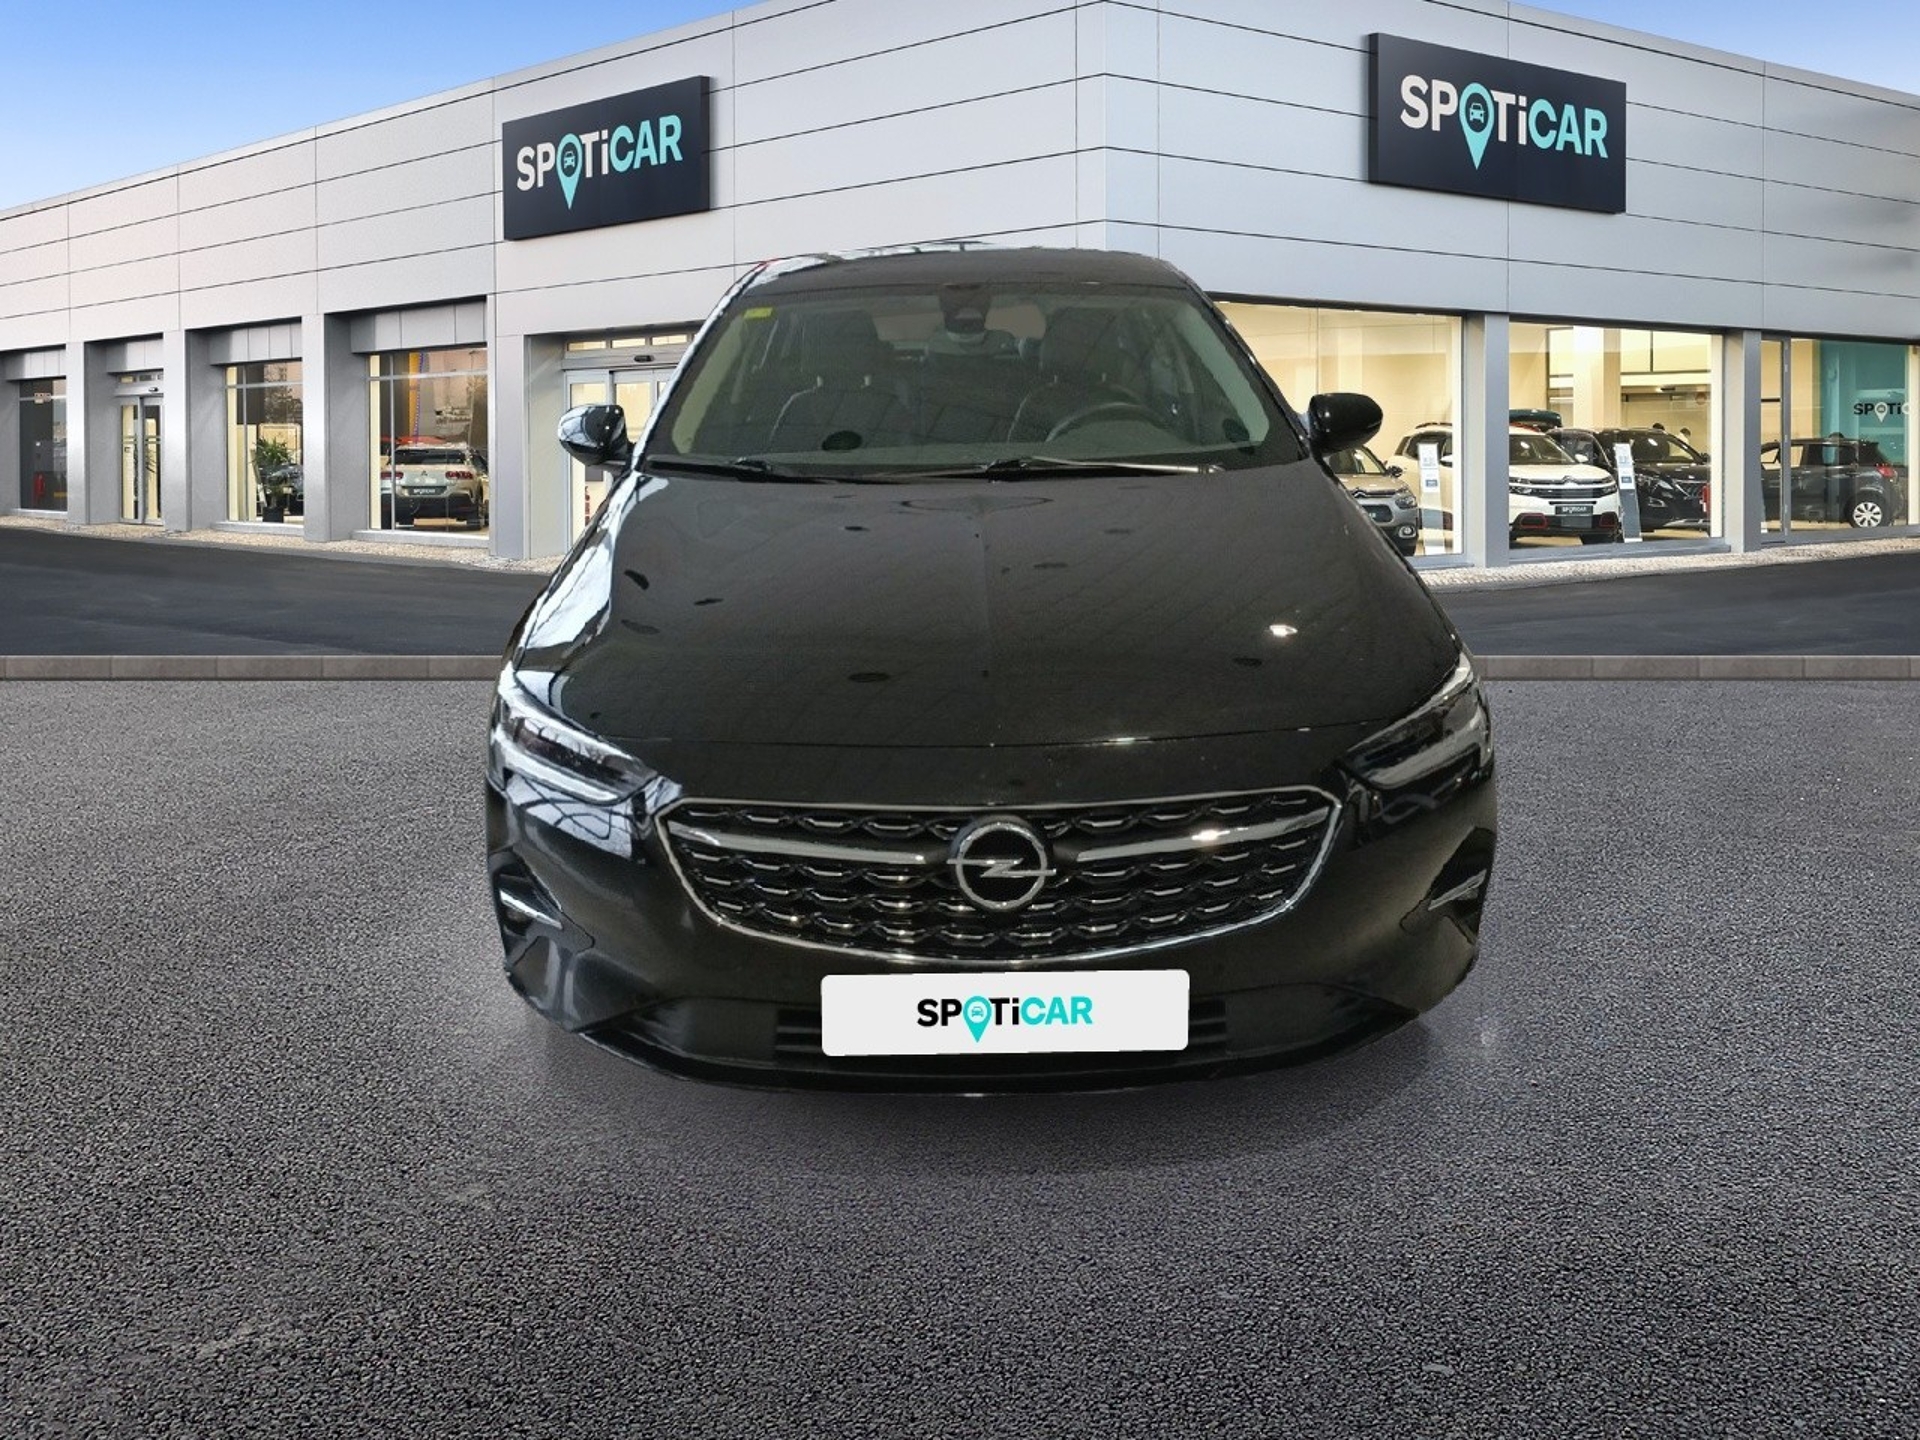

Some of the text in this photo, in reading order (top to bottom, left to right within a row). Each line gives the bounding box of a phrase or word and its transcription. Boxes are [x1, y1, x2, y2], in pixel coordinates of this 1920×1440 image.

[516, 114, 683, 210] SPOTiCAR
[1400, 74, 1609, 170] SPOTiCAR
[916, 995, 1093, 1043] SPOTiCAR
